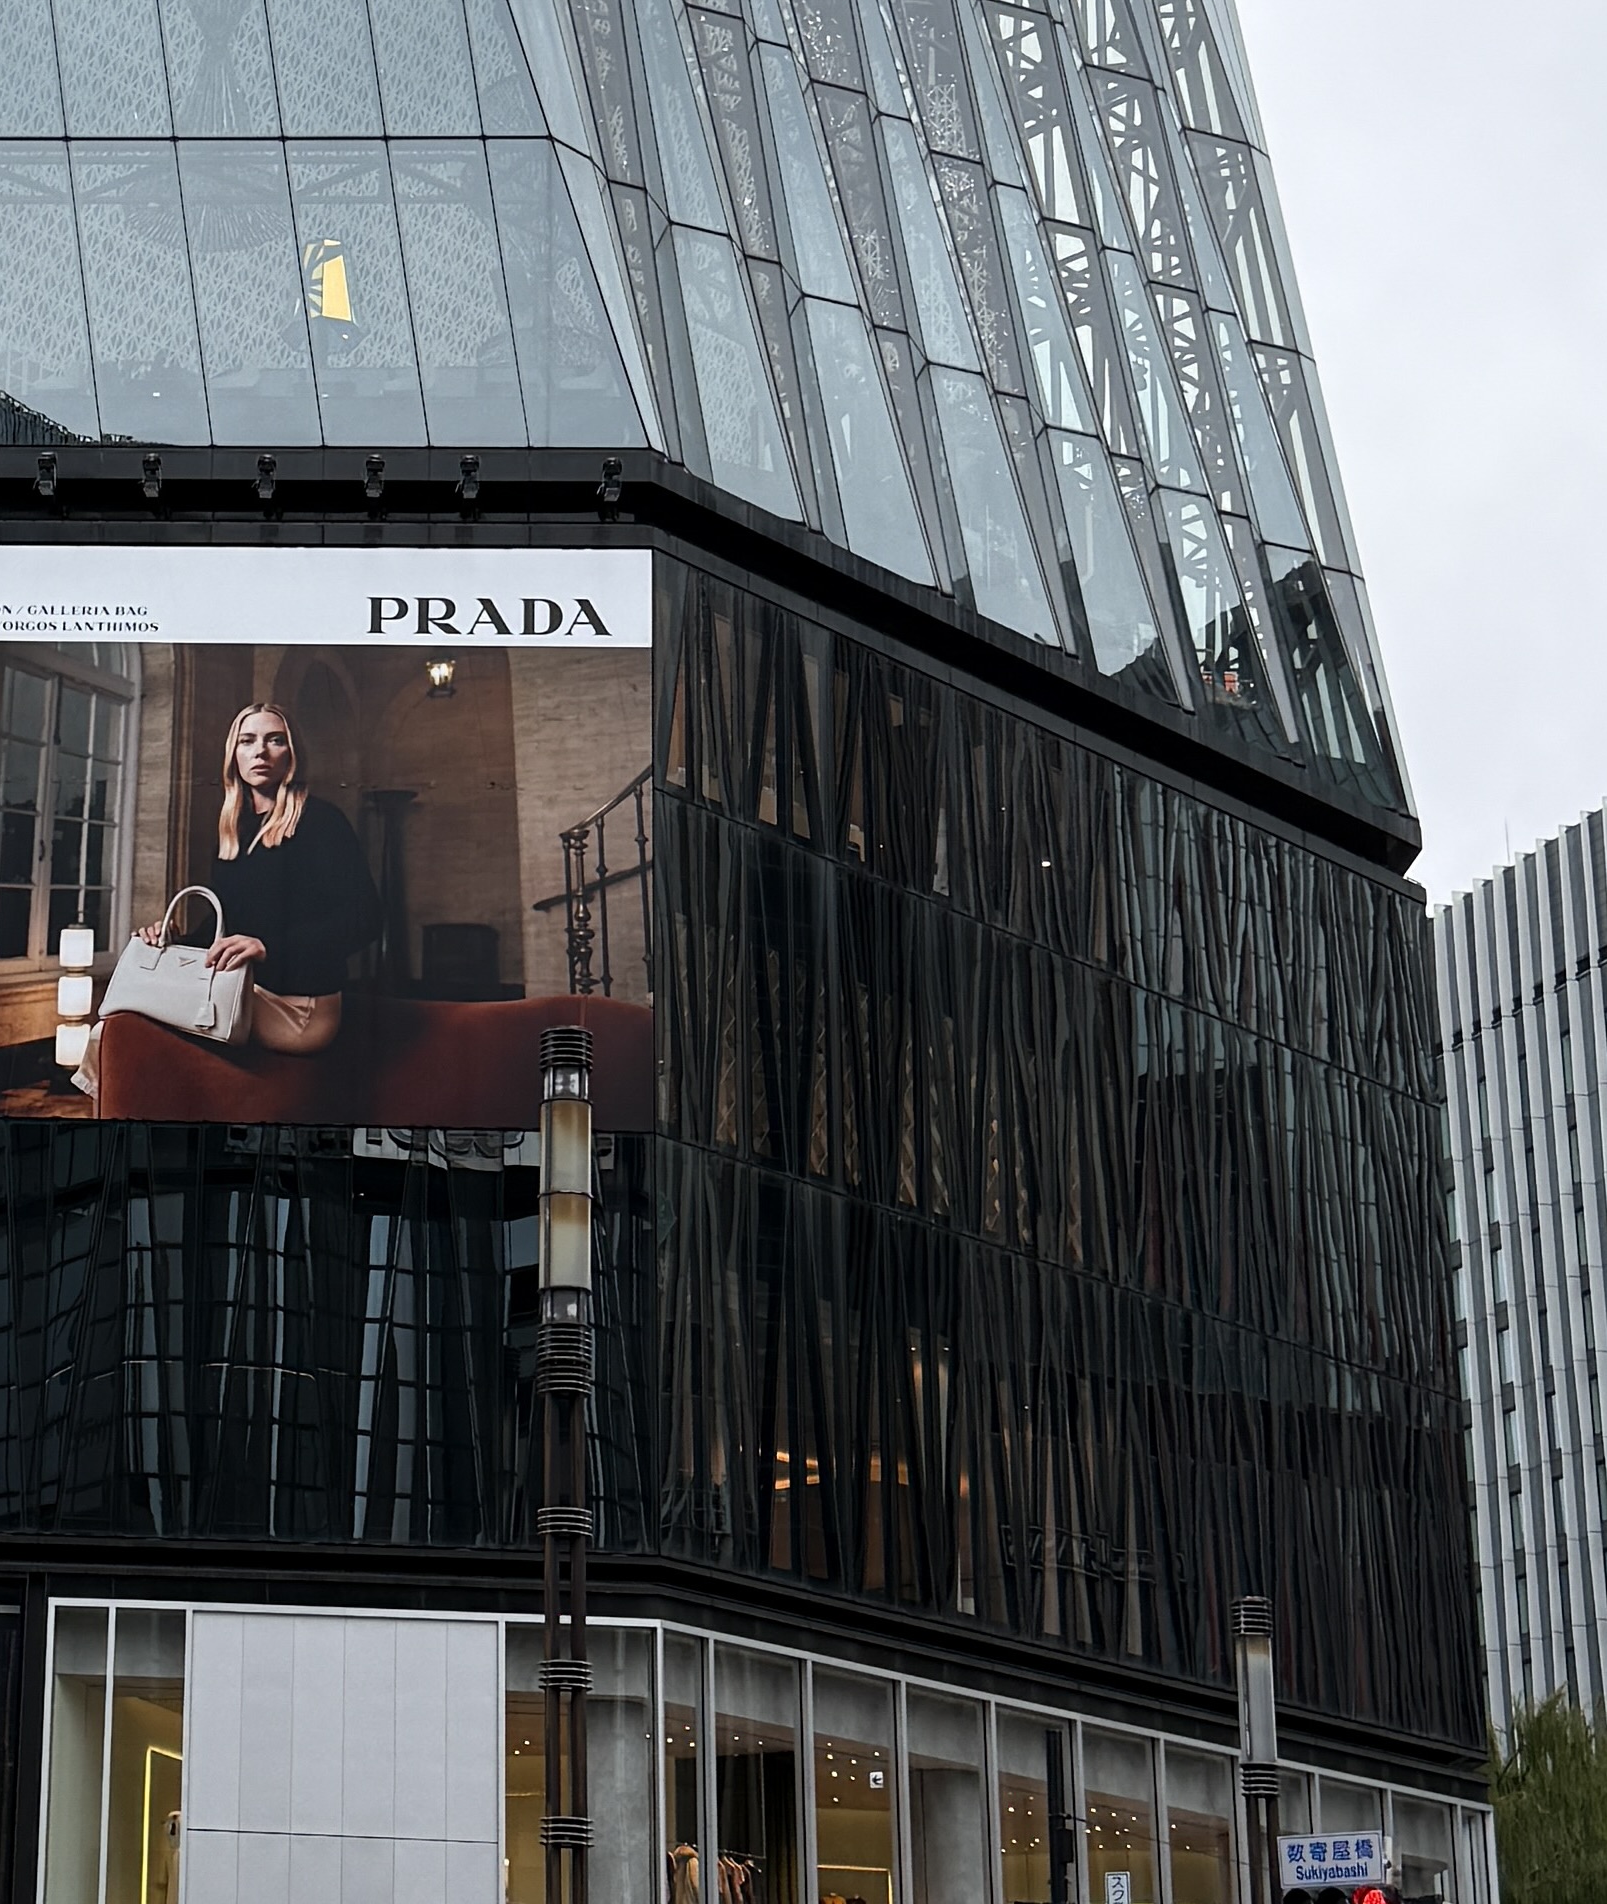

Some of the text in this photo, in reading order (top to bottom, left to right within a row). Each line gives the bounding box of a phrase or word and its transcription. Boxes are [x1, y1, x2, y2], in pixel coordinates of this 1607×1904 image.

[27, 604, 110, 616] GALLERIA
[115, 605, 148, 616] BAG
[366, 596, 613, 637] PRADA
[62, 620, 160, 633] LANTHIMOS
[1286, 1838, 1374, 1864] 数寄屋橋
[1295, 1862, 1369, 1882] Sukiyabashi
